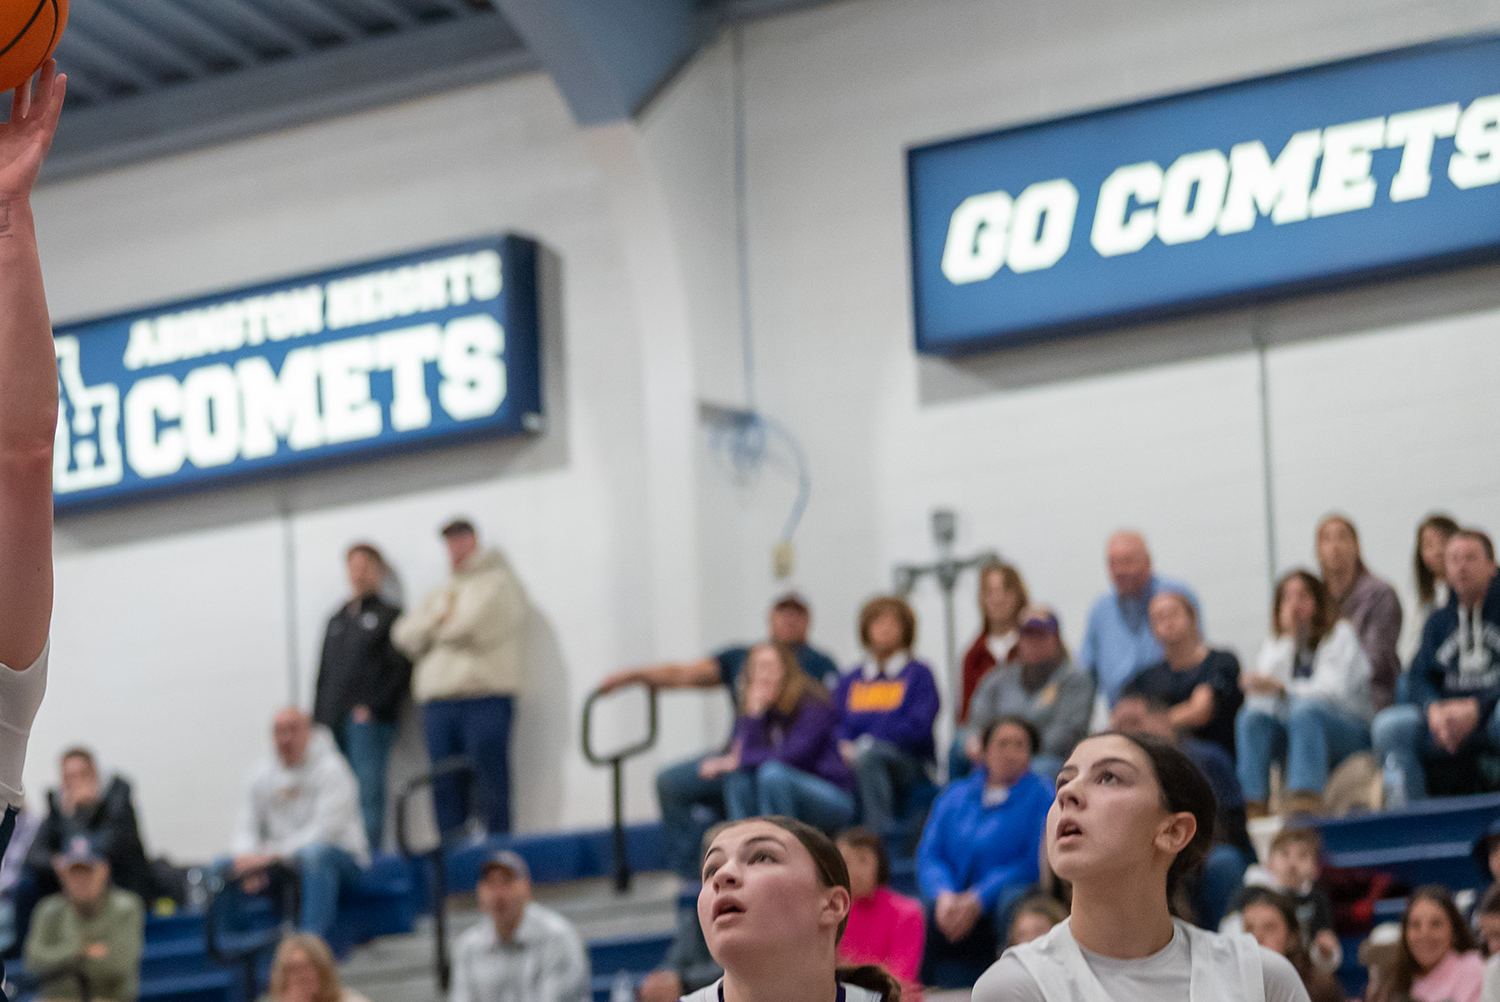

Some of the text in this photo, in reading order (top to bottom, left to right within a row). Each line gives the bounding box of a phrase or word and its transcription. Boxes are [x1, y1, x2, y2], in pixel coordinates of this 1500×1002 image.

[941, 94, 1500, 285] GO COMETS
[325, 250, 503, 330] HEIGHTS
[124, 314, 506, 479] COMETS
